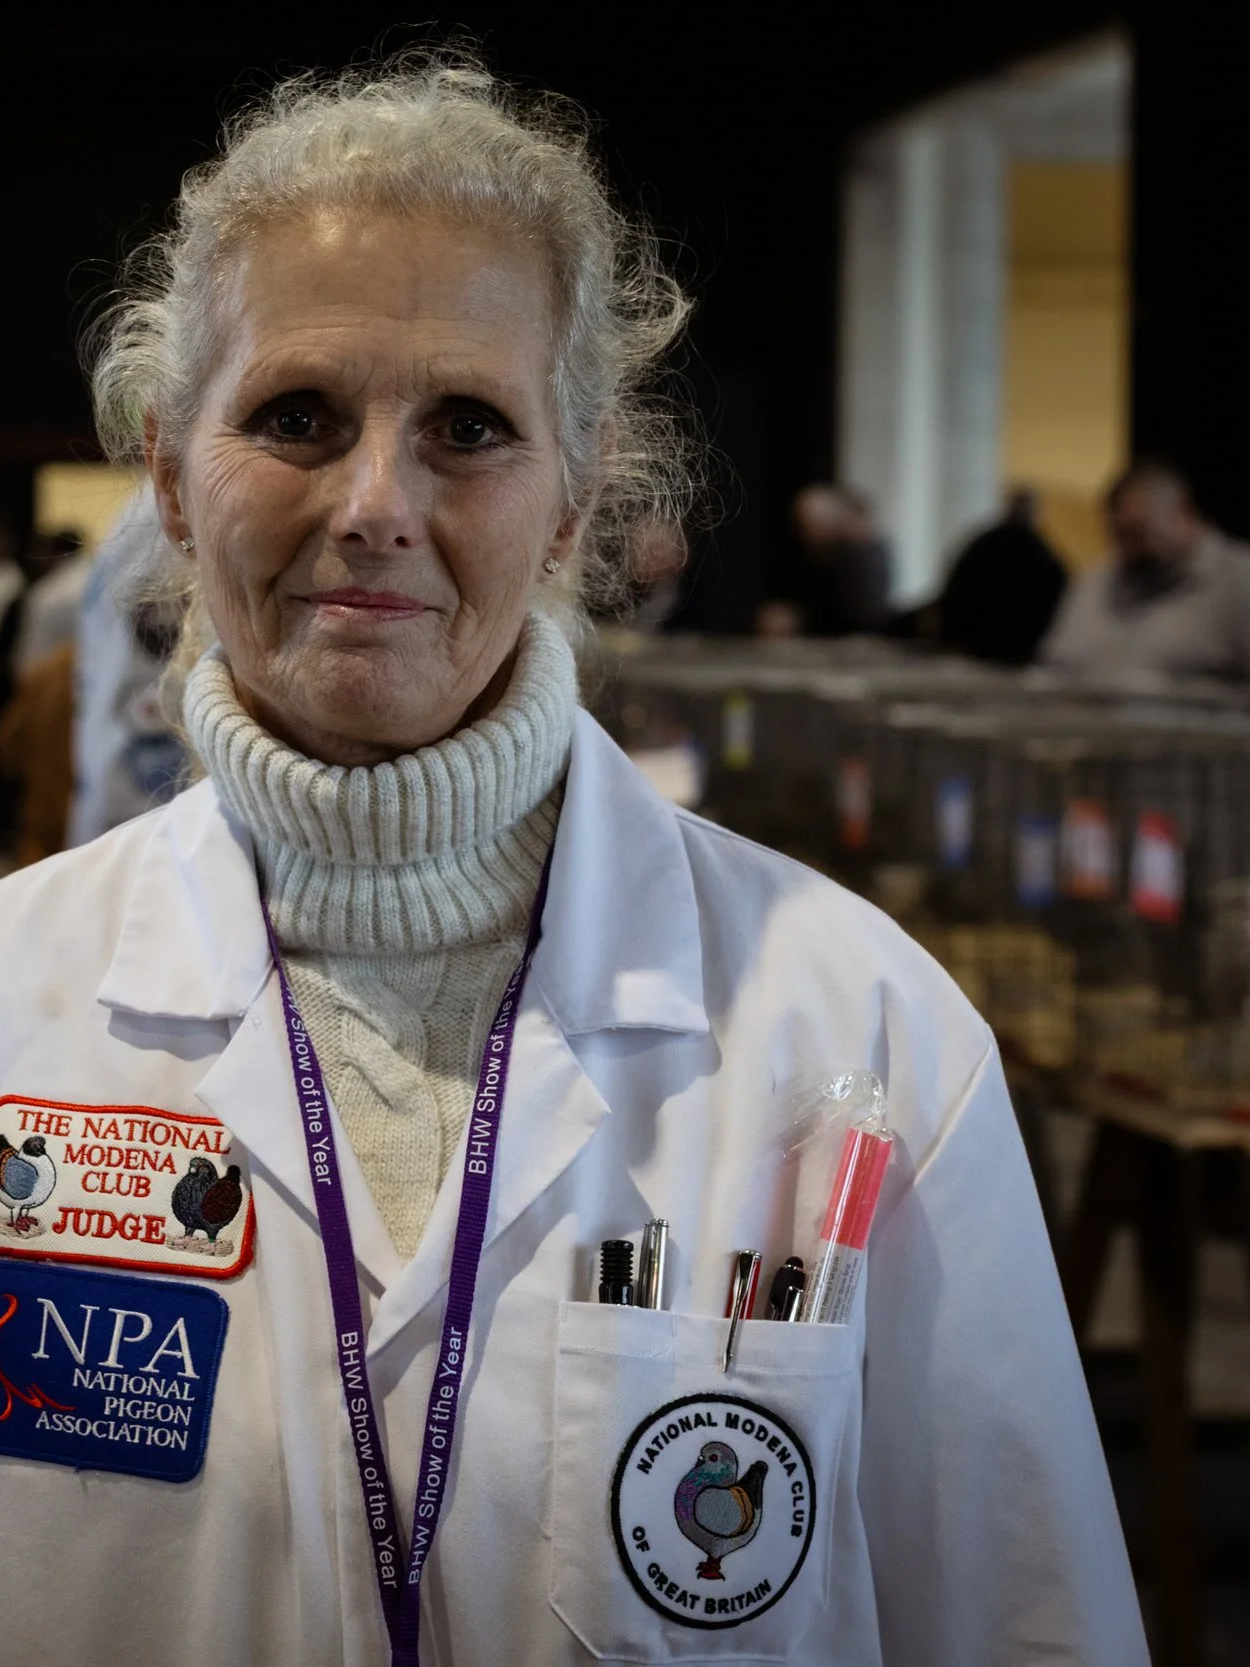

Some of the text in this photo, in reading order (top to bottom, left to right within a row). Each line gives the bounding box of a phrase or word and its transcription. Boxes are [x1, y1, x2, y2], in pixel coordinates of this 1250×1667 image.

[494, 1001, 512, 1031] the
[291, 1017, 312, 1072] Show
[490, 1034, 505, 1053] of
[301, 1077, 320, 1096] of
[477, 1060, 500, 1113] Show
[17, 1110, 232, 1155] THE NATIONAL
[304, 1098, 323, 1134] the
[62, 1144, 178, 1174] MODENA
[311, 1136, 331, 1187] Year
[468, 1118, 492, 1175] BHW
[81, 1171, 151, 1198] CLUB
[52, 1207, 167, 1244] JUDGE
[32, 1297, 200, 1380] NPA
[73, 1368, 195, 1401] NATIONAL
[35, 1409, 188, 1451] ASSOCIATION
[103, 1398, 193, 1426] PIGEON
[341, 1331, 398, 1590] BHW Show of the Year
[408, 1327, 463, 1585] BHW Show of the Year
[636, 1412, 804, 1538] NATIONAL MODENA CLUB
[632, 1525, 772, 1615] OF GREAT BRITAIN
